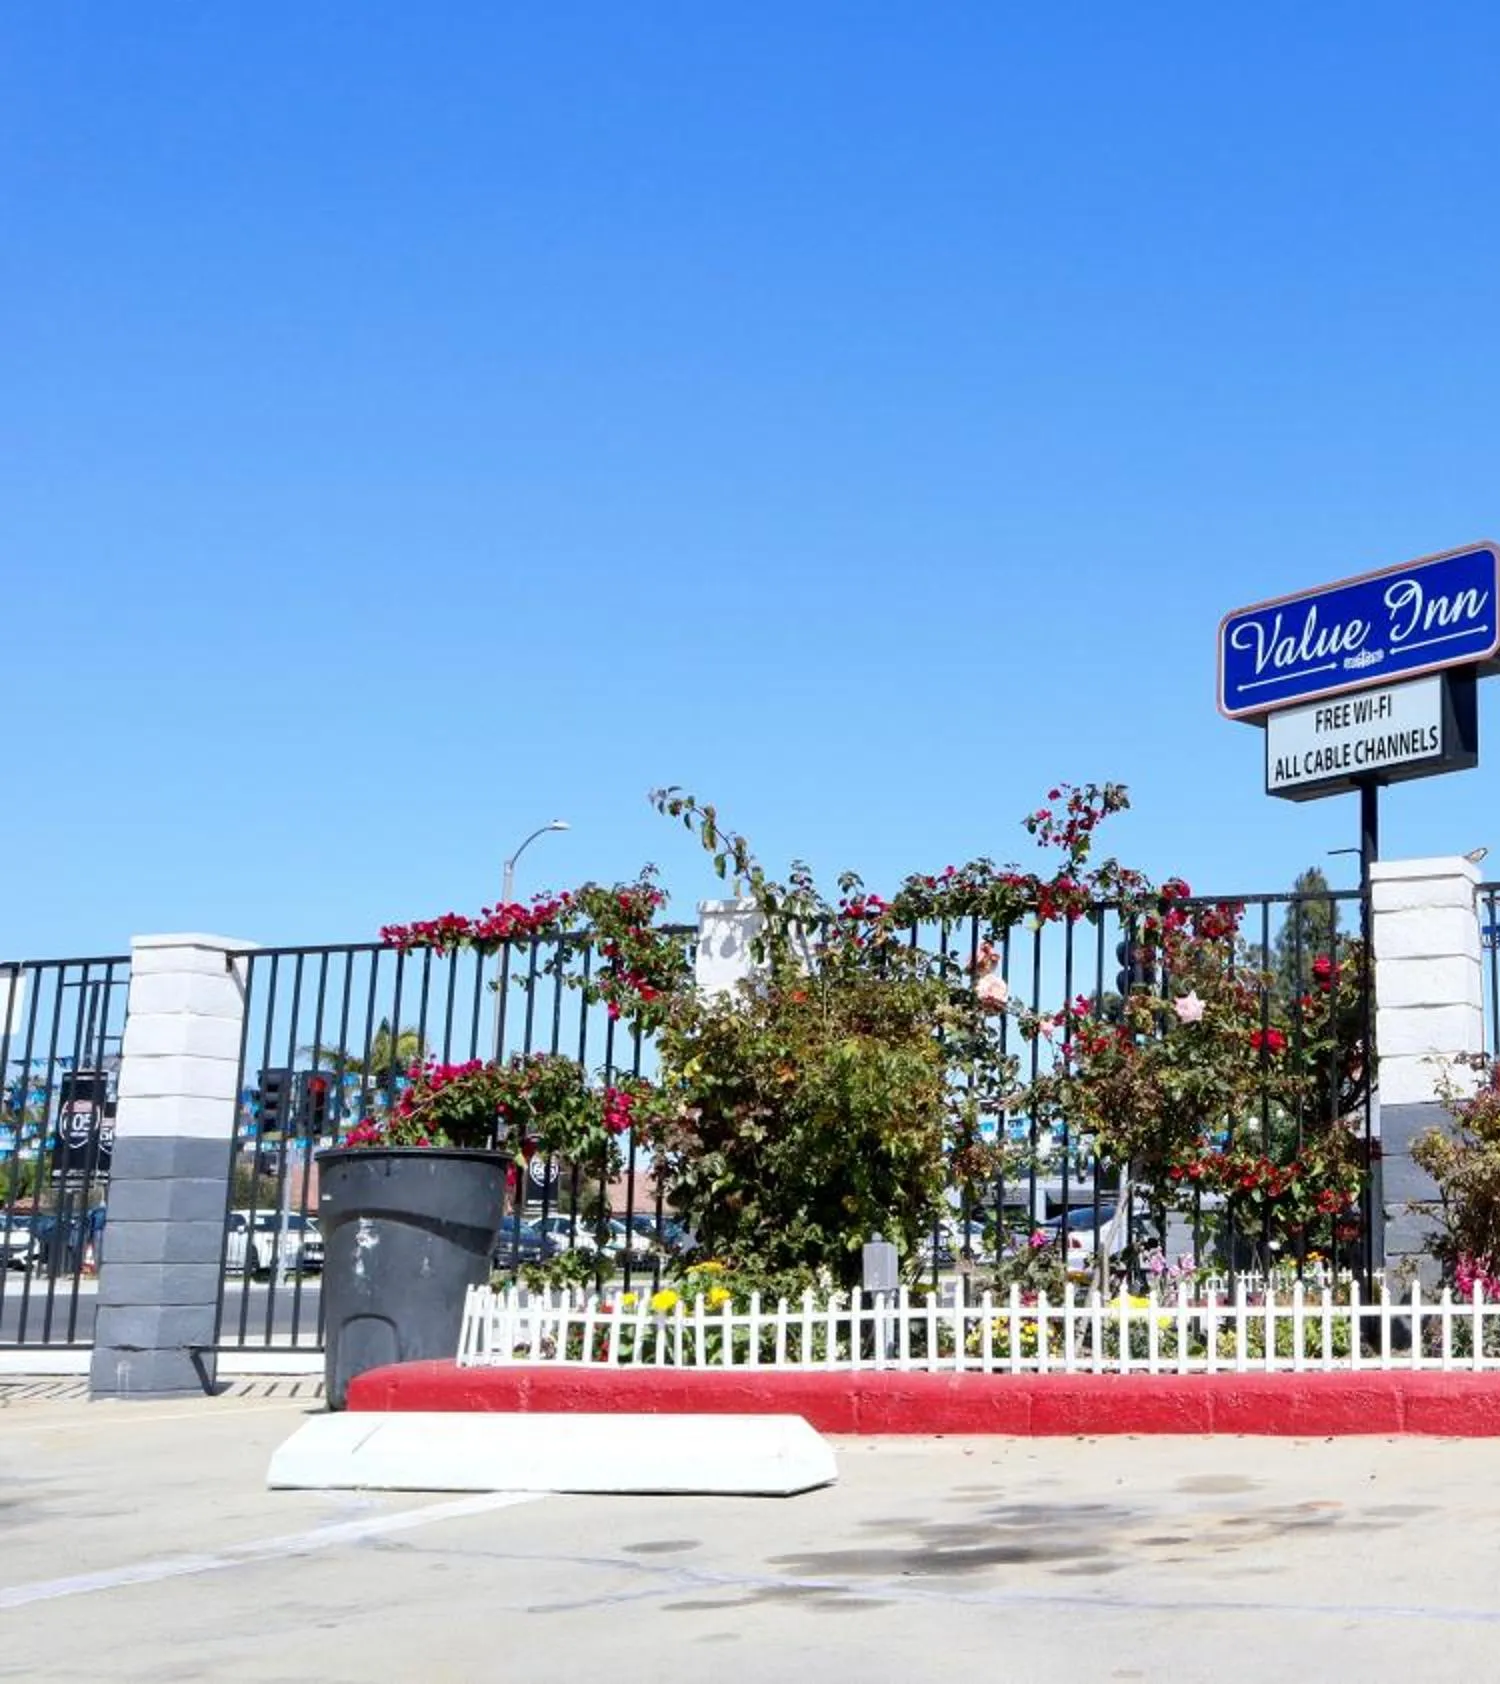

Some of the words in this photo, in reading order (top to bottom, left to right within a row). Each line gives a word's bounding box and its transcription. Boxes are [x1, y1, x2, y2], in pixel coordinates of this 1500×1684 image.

[1231, 605, 1370, 674] Value
[1384, 579, 1488, 642] Inn
[1315, 704, 1351, 733] FREE
[1353, 694, 1392, 724] WI-FI
[1275, 755, 1300, 781] ALL
[1304, 743, 1350, 774] CABLE
[1354, 725, 1438, 764] CHANNELS
